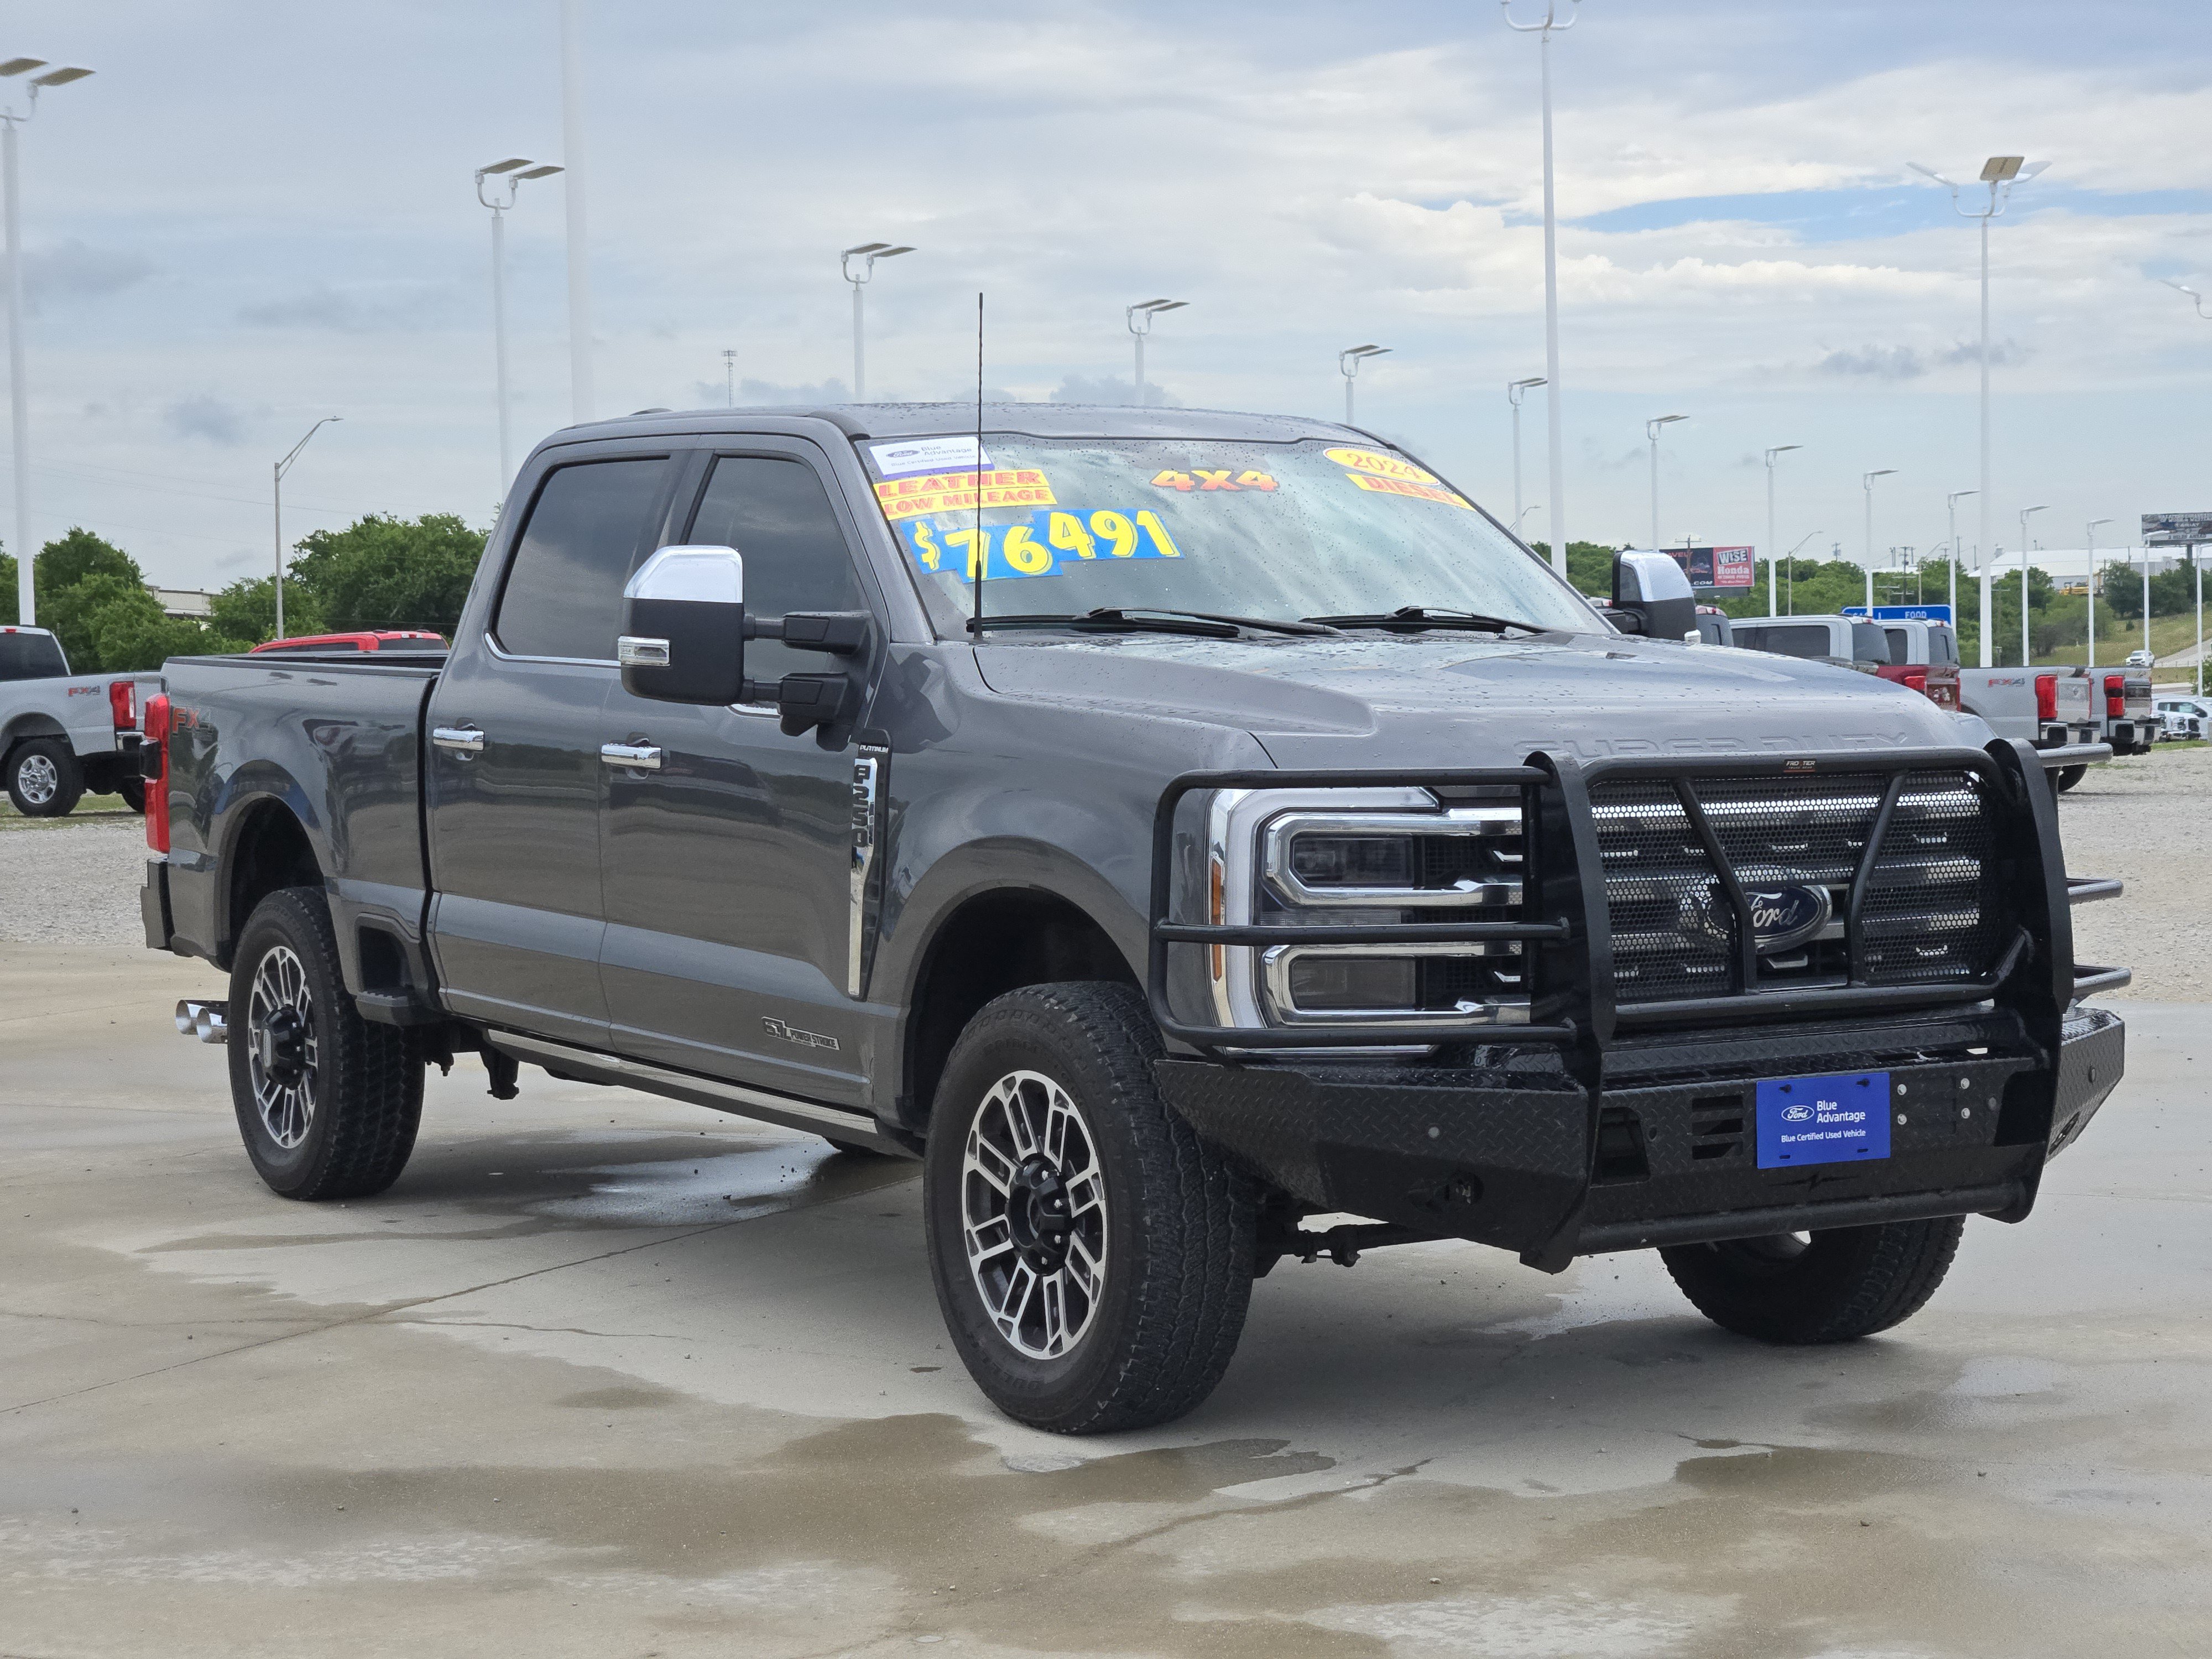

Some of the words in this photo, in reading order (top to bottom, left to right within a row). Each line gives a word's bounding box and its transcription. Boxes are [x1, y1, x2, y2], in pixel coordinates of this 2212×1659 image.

[924, 447, 973, 456] Advantage
[1347, 453, 1423, 480] 2024
[878, 471, 1042, 498] LEATHER
[1150, 470, 1280, 492] 4X4
[1361, 476, 1467, 508] DIESEL
[884, 497, 935, 515] LOW
[942, 489, 1051, 507] MILEAGE
[1718, 549, 1747, 565] WISE
[1717, 565, 1750, 575] Honda
[860, 744, 889, 754] PLATINUM
[1745, 891, 1799, 928] Ford
[1816, 1100, 1838, 1112] Blue
[1816, 1110, 1866, 1124] Advantage
[1781, 1135, 1796, 1143] Blue
[1797, 1133, 1824, 1141] Certified
[1825, 1131, 1842, 1140] Used
[1843, 1129, 1866, 1138] Vehicle
